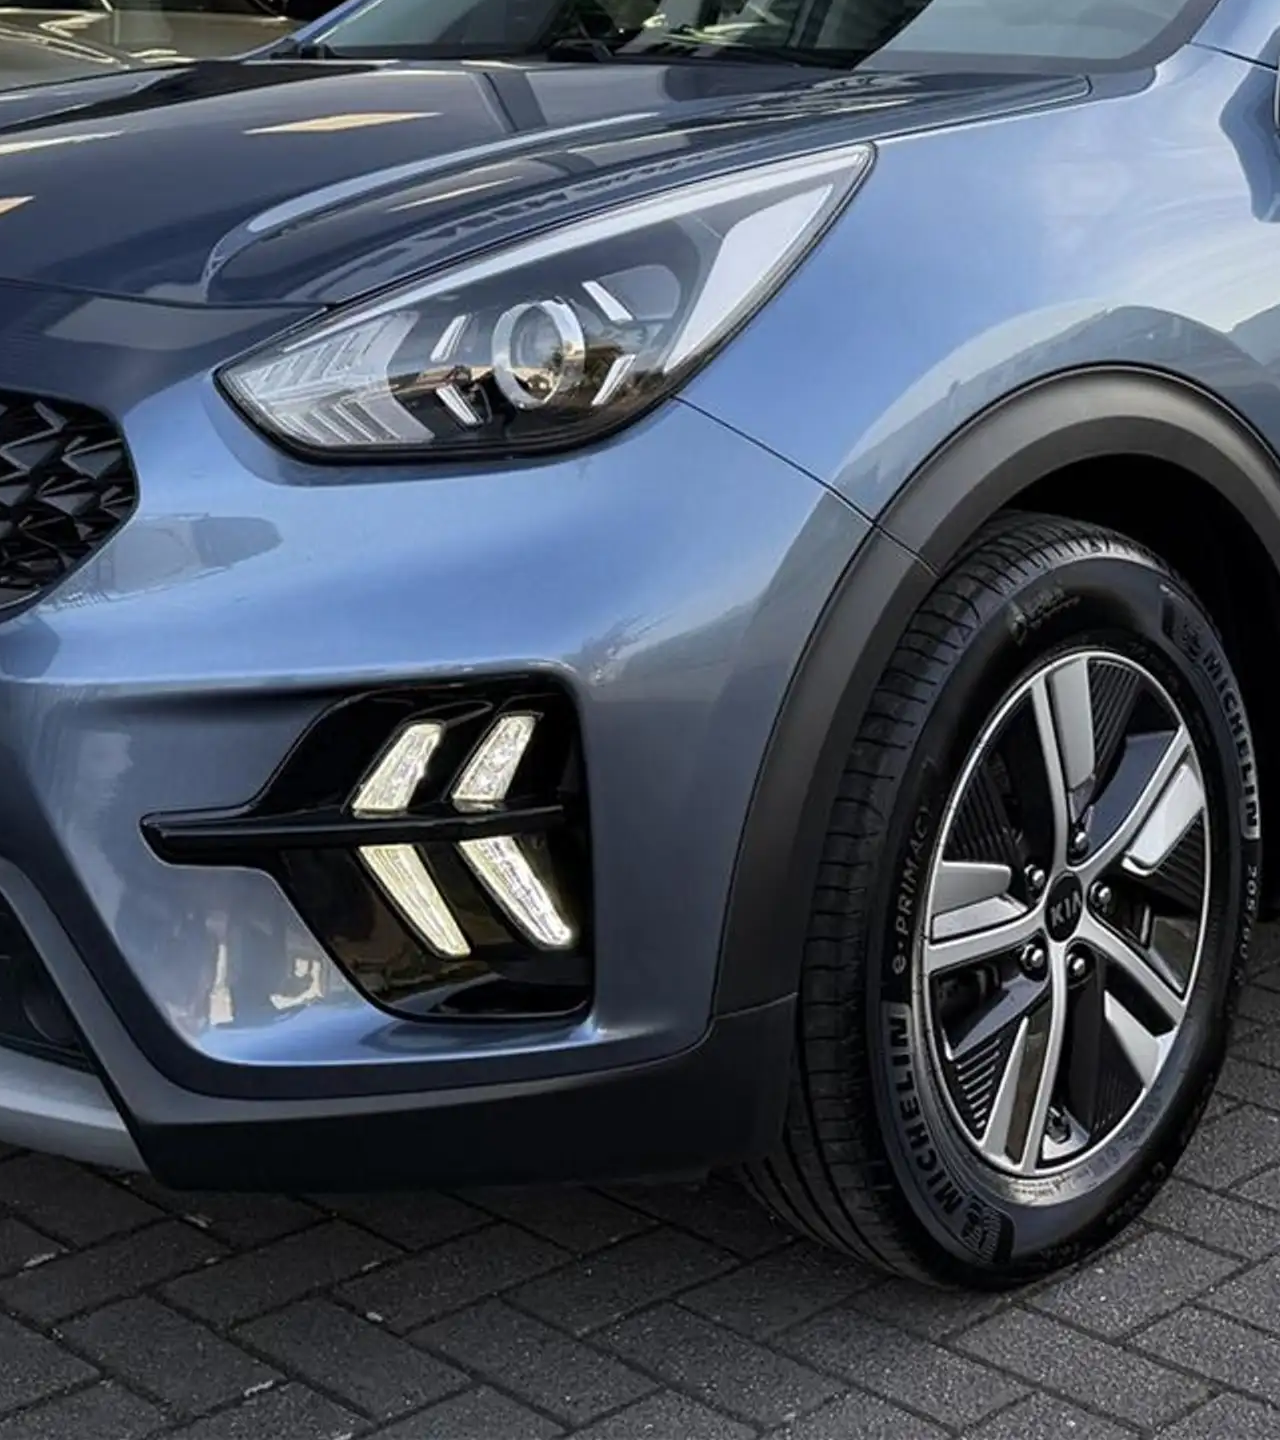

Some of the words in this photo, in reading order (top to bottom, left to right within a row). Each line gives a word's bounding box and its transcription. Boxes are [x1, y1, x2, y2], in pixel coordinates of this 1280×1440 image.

[1202, 649, 1258, 828] MICHELIN
[1050, 890, 1083, 930] KIA
[888, 1016, 965, 1215] MICHELIN
